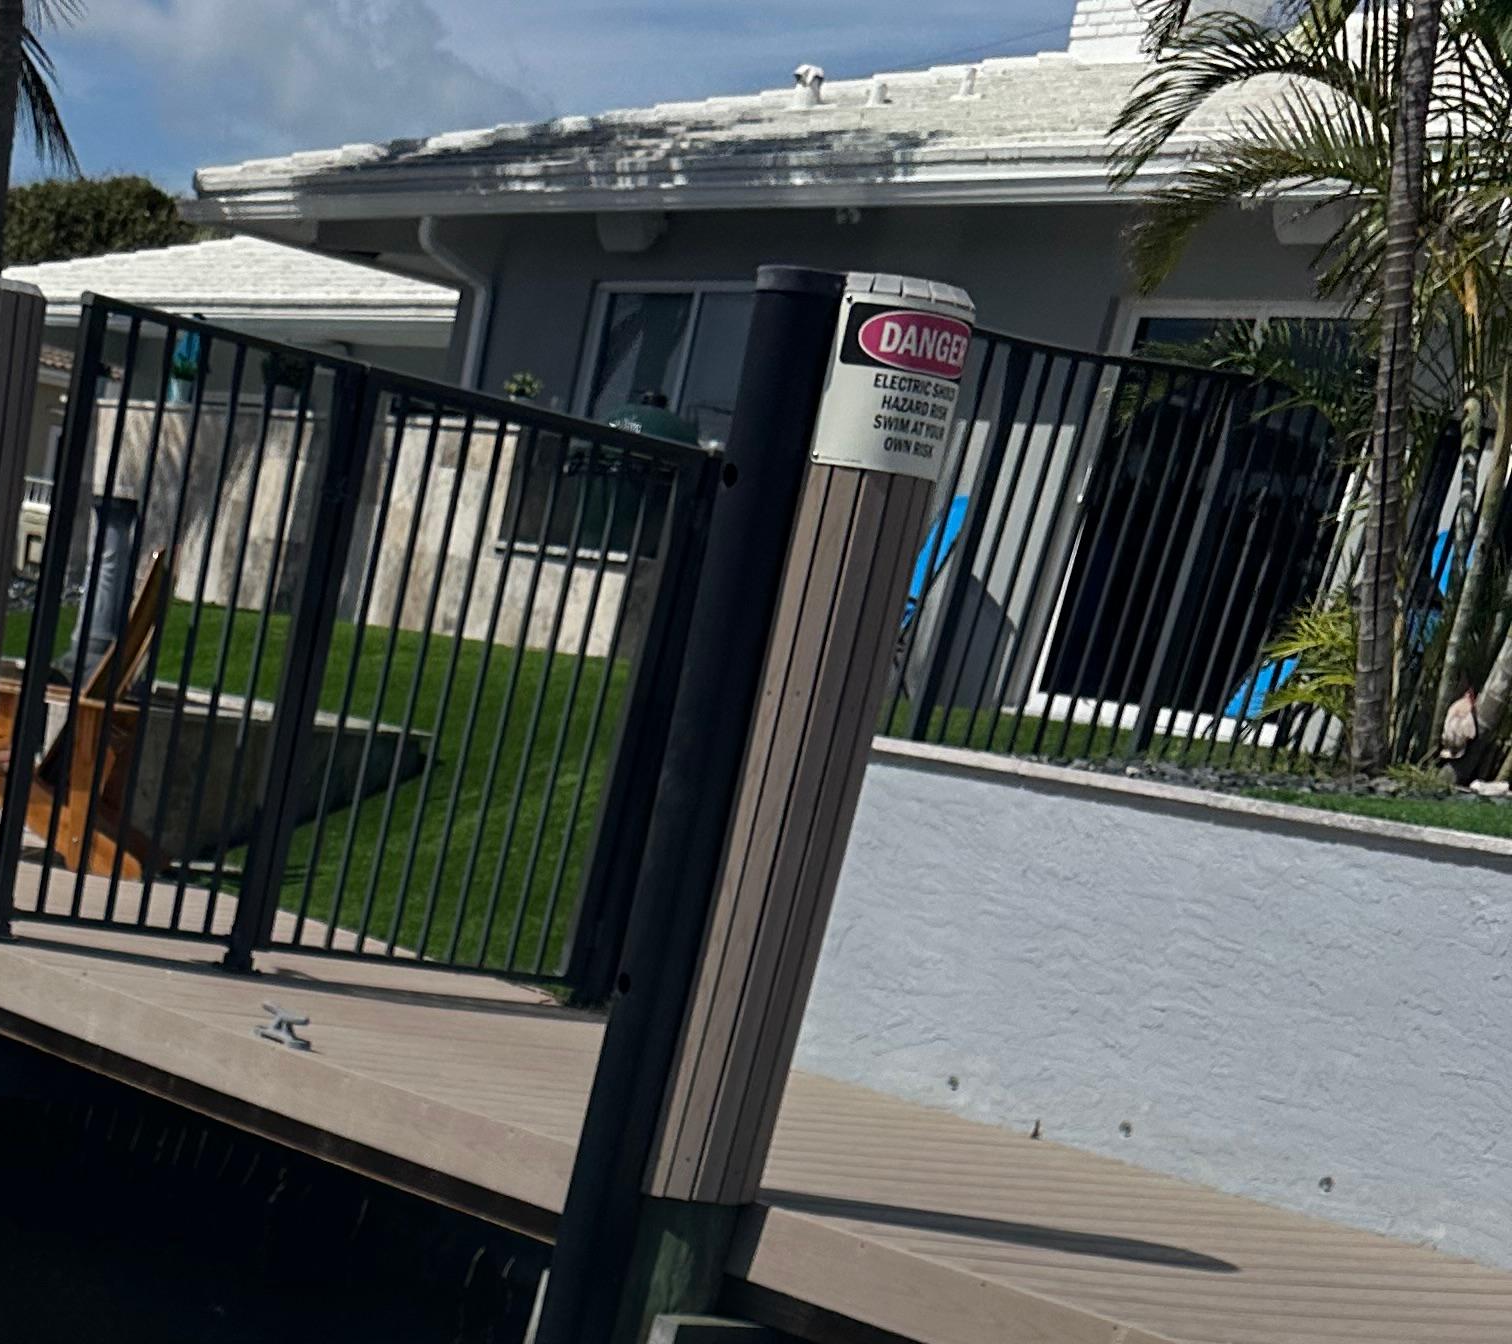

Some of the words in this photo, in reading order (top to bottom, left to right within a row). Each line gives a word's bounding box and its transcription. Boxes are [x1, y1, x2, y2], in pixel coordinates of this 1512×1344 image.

[879, 320, 968, 368] DANGER
[873, 373, 932, 396] ELECTRIC
[881, 393, 929, 416] HAZARD
[873, 414, 910, 435] SWIM
[910, 420, 925, 436] AT
[883, 437, 910, 454] OWN
